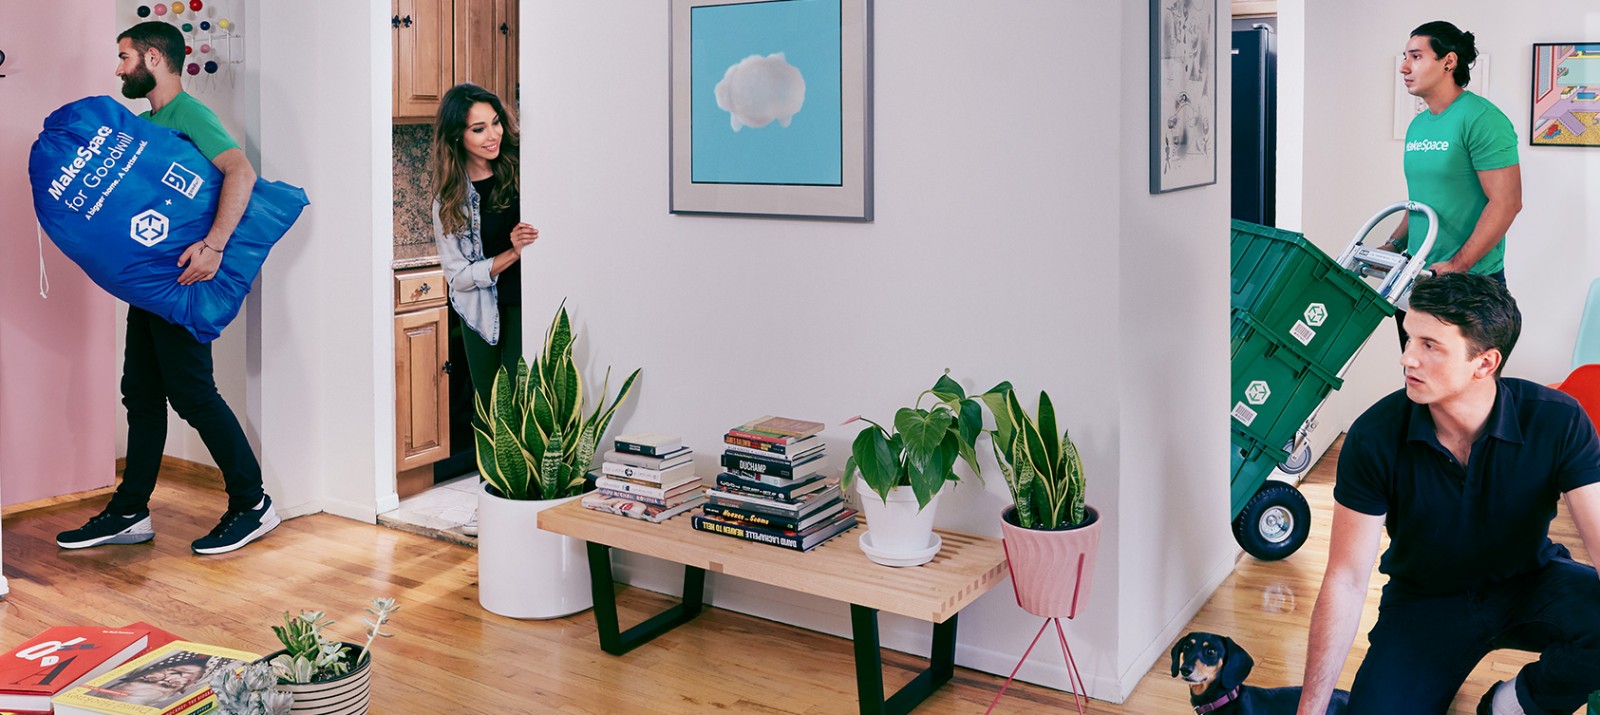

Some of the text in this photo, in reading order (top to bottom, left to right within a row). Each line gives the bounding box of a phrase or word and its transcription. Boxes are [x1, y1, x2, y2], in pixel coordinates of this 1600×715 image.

[48, 125, 113, 201] MakeSpace
[121, 153, 138, 173] better
[64, 131, 134, 212] for Goodwill
[117, 171, 126, 179] A
[102, 178, 121, 197] home.
[88, 195, 106, 216] bigger
[84, 212, 93, 221] A
[739, 460, 767, 473] DUCHAMP
[702, 521, 716, 531] HELL
[715, 523, 723, 532] TO
[723, 525, 745, 537] HEAVEN
[745, 530, 780, 545] LACHAPELLE
[780, 538, 797, 549] DAVID
